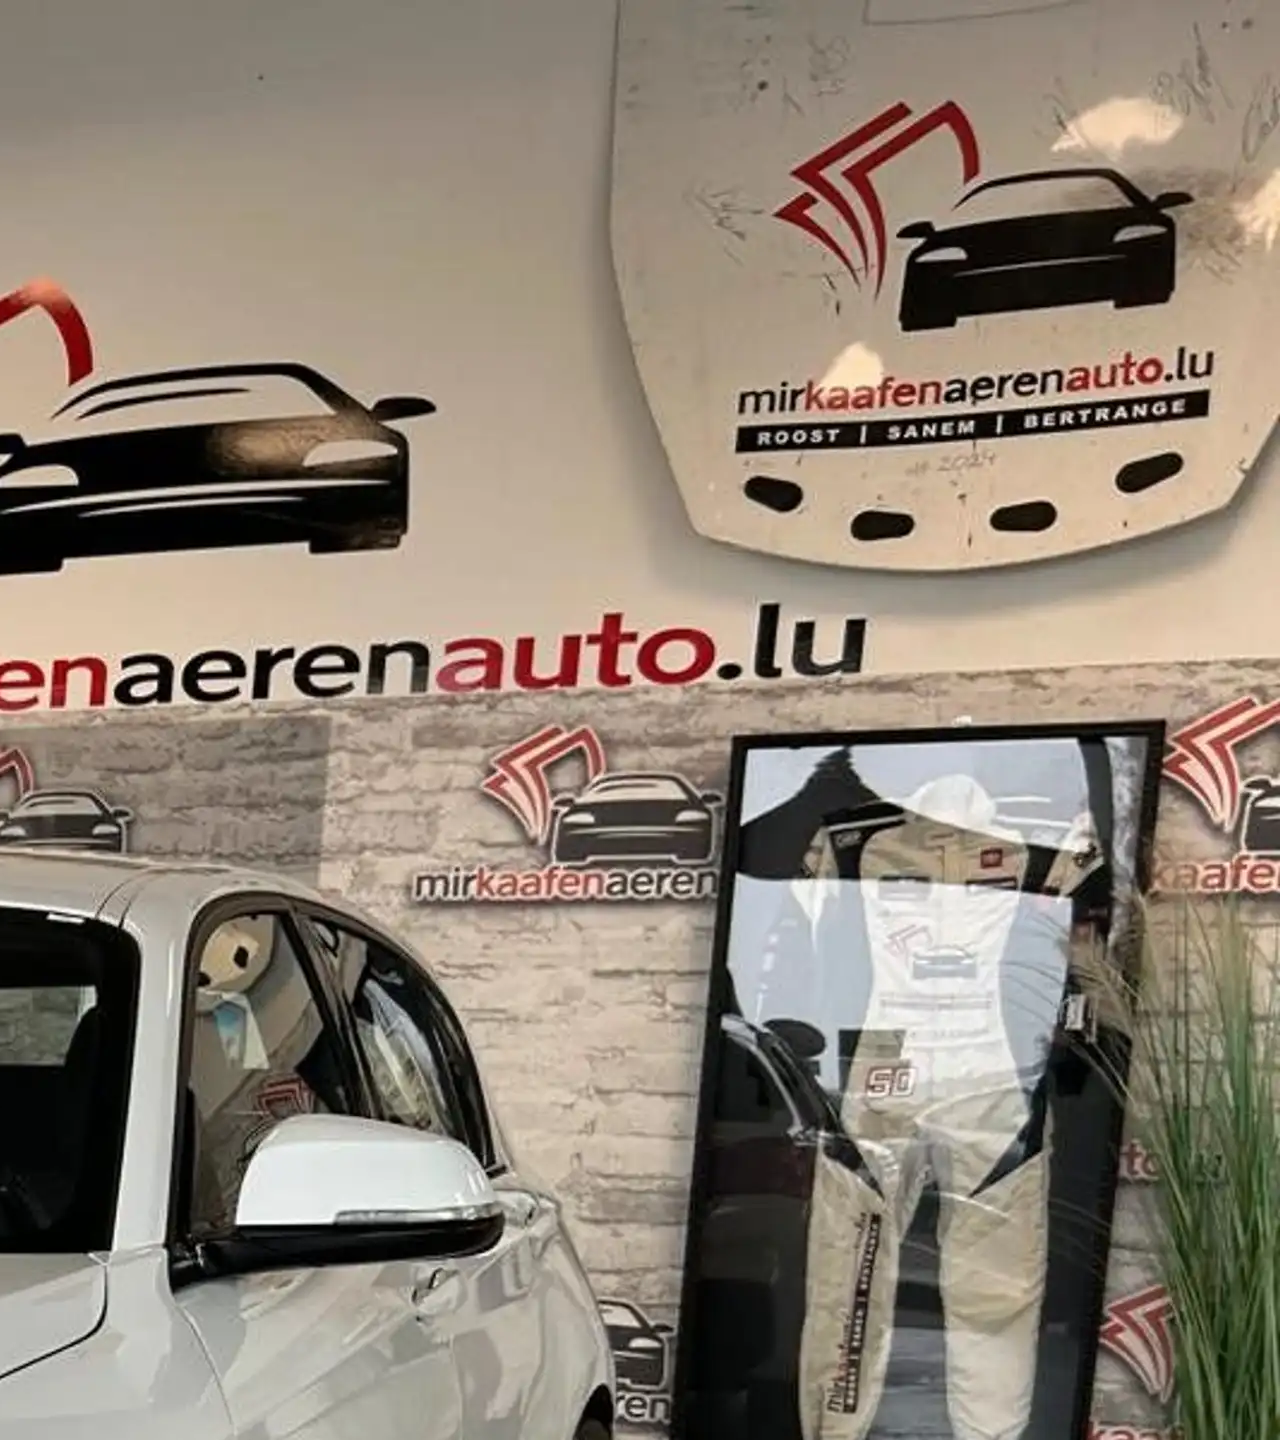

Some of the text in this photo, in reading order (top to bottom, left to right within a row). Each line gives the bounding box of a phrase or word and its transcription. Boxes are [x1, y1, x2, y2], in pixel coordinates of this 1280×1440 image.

[737, 346, 1215, 415] mirkaafenaerenauto.lu
[757, 428, 840, 445] ROOST
[887, 420, 975, 440] SANEM
[1024, 398, 1186, 429] BERTRANGE
[416, 866, 718, 897] mirkaafenaeren
